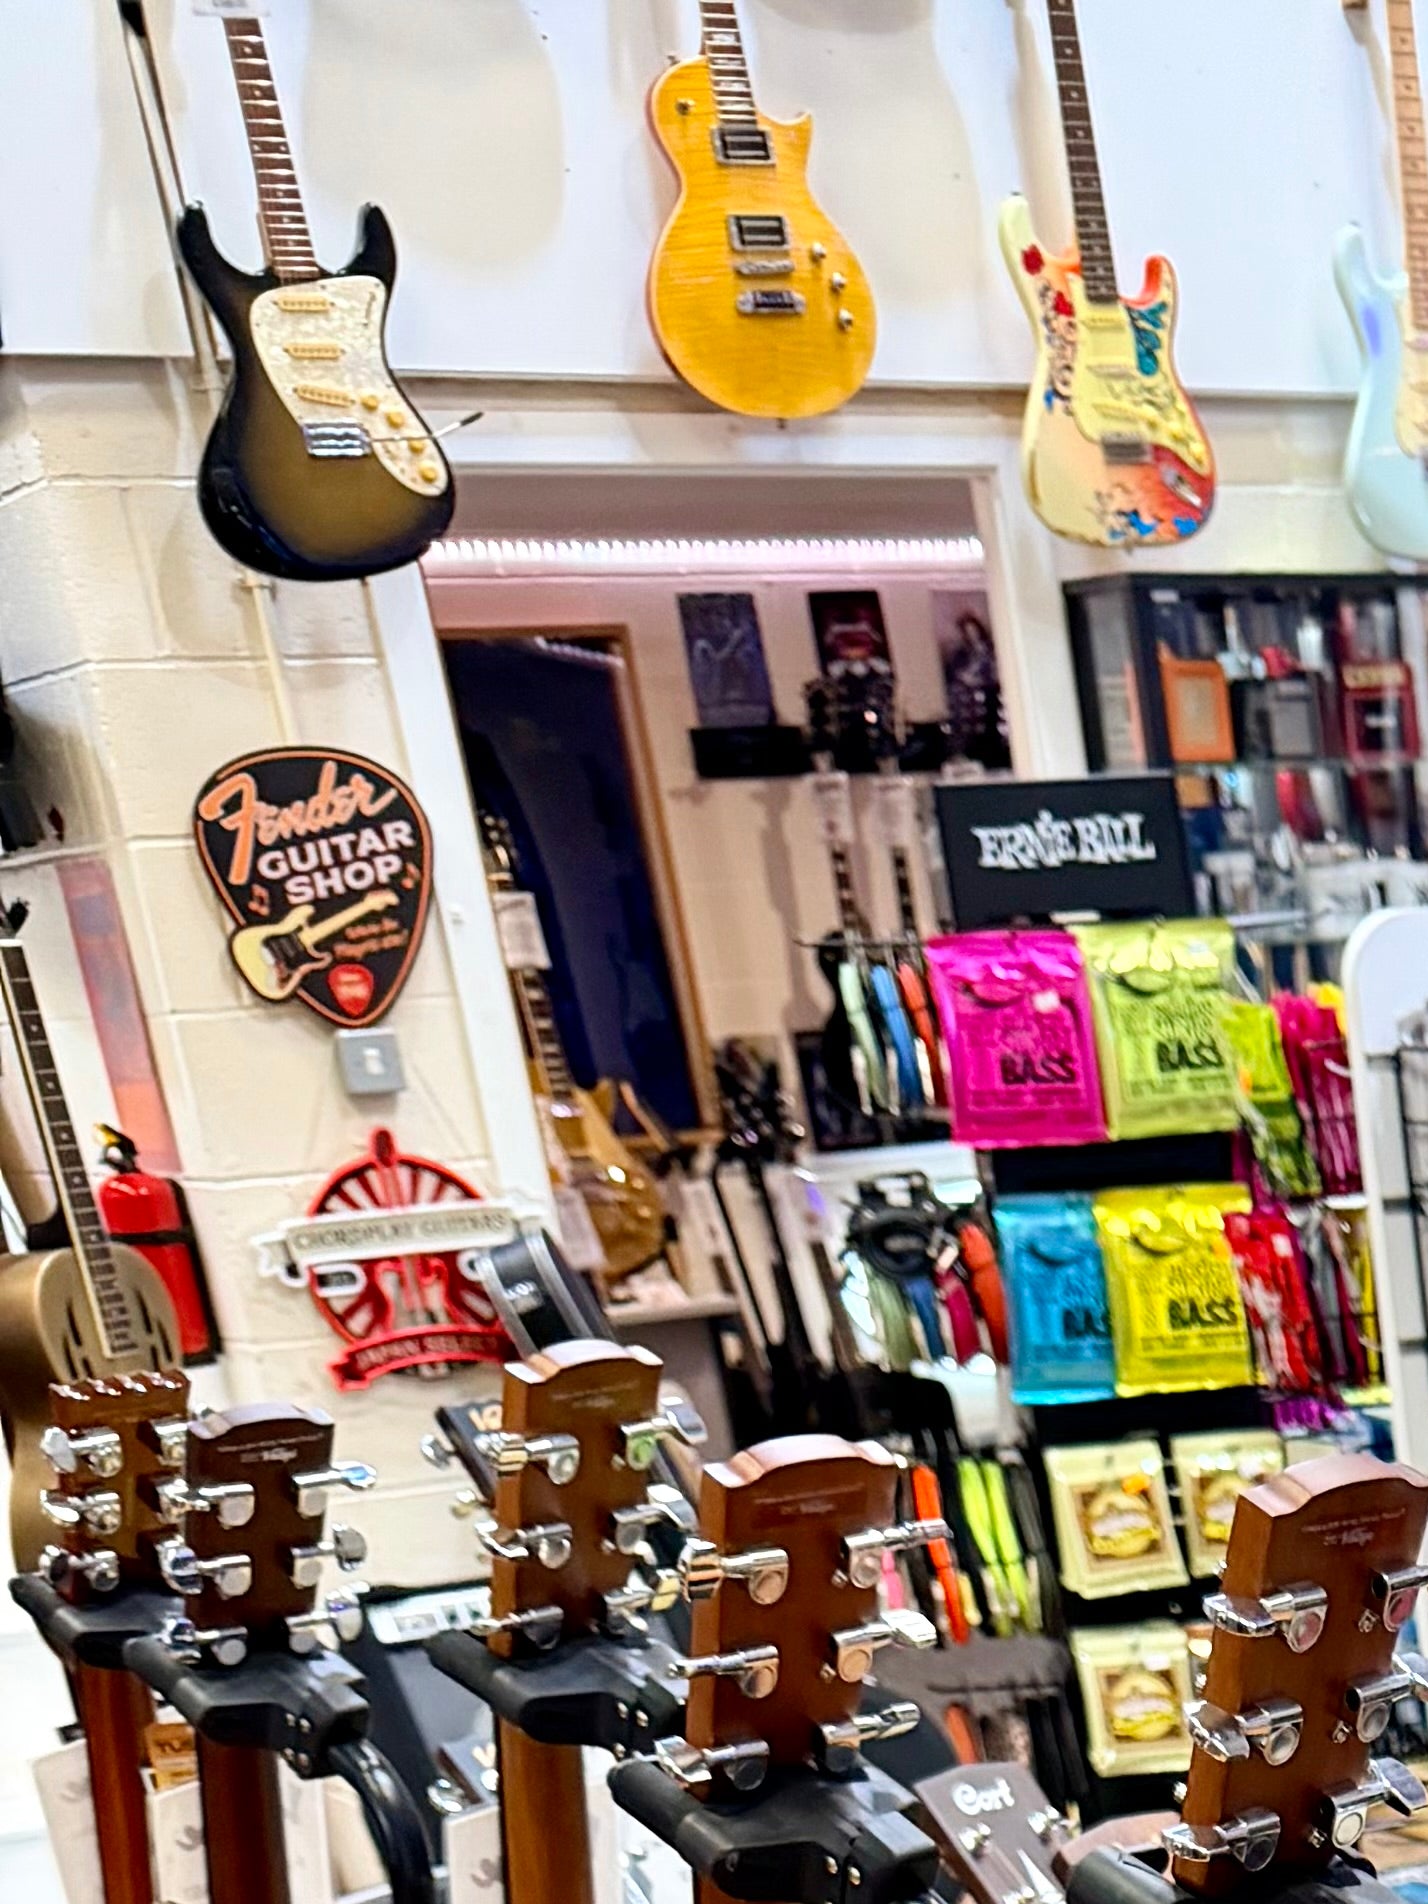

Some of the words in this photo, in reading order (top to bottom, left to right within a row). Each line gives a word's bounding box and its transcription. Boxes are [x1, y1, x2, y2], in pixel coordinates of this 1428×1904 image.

[199, 760, 398, 886] Fender
[256, 820, 417, 881] GUITAR
[970, 809, 1075, 870] ERNIE
[1074, 811, 1157, 865] BALL
[284, 854, 402, 905] SHOP
[950, 1776, 1015, 1816] Cort
